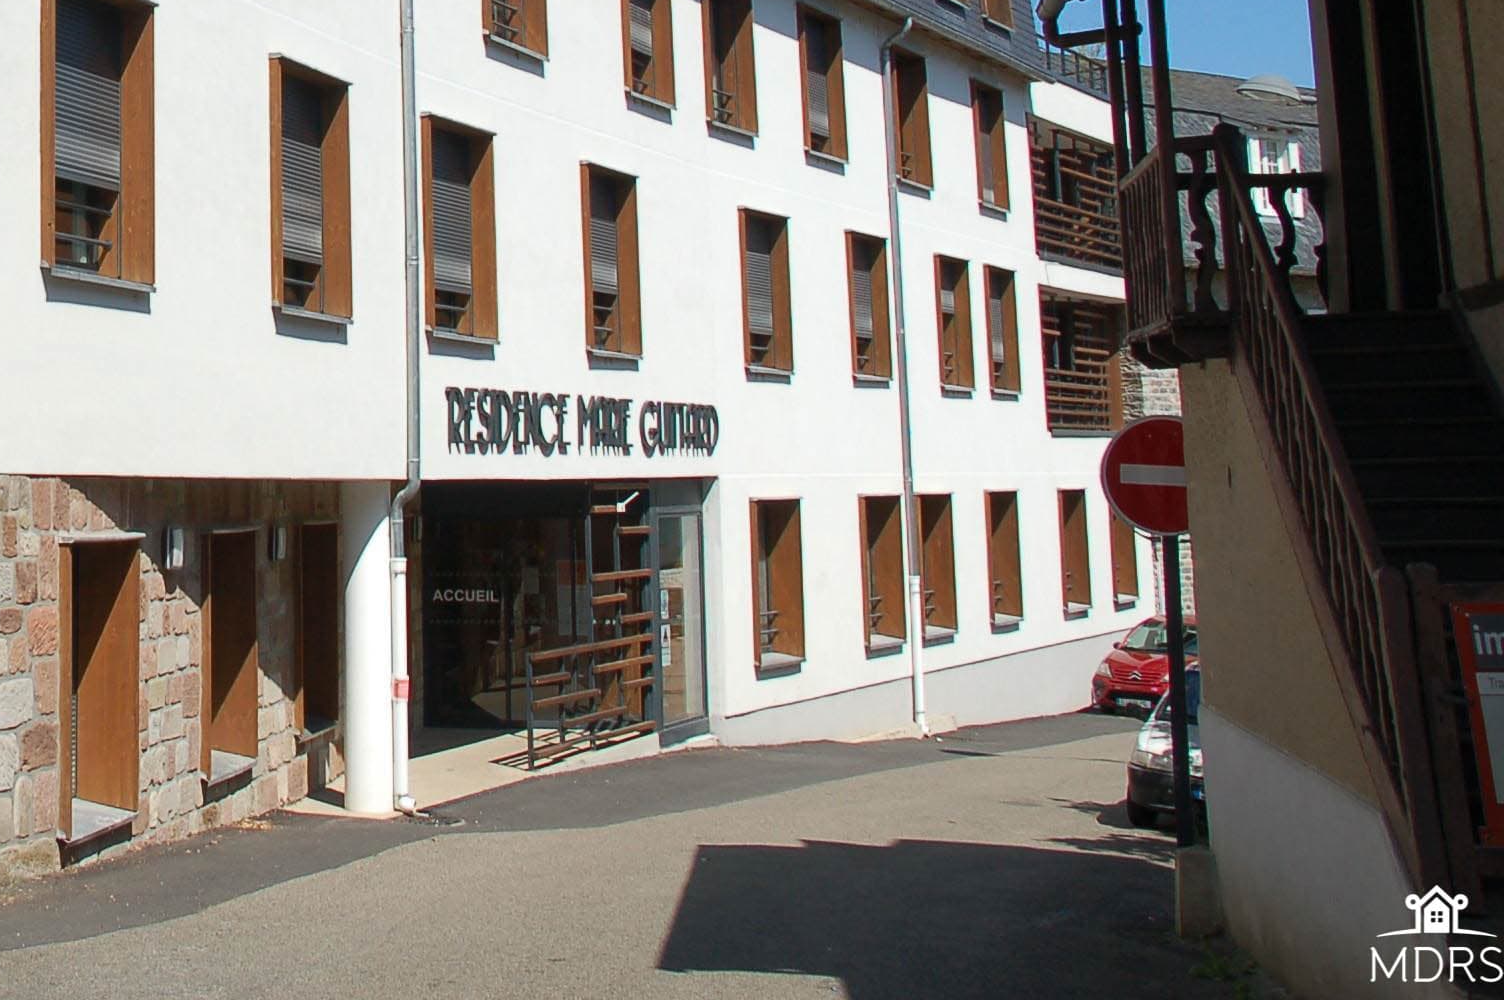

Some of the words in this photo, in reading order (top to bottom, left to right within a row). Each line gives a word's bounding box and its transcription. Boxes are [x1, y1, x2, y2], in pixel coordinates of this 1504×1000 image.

[445, 386, 571, 457] RESIDENCE
[577, 395, 633, 456] MARIE
[432, 589, 500, 603] ACCUEIL
